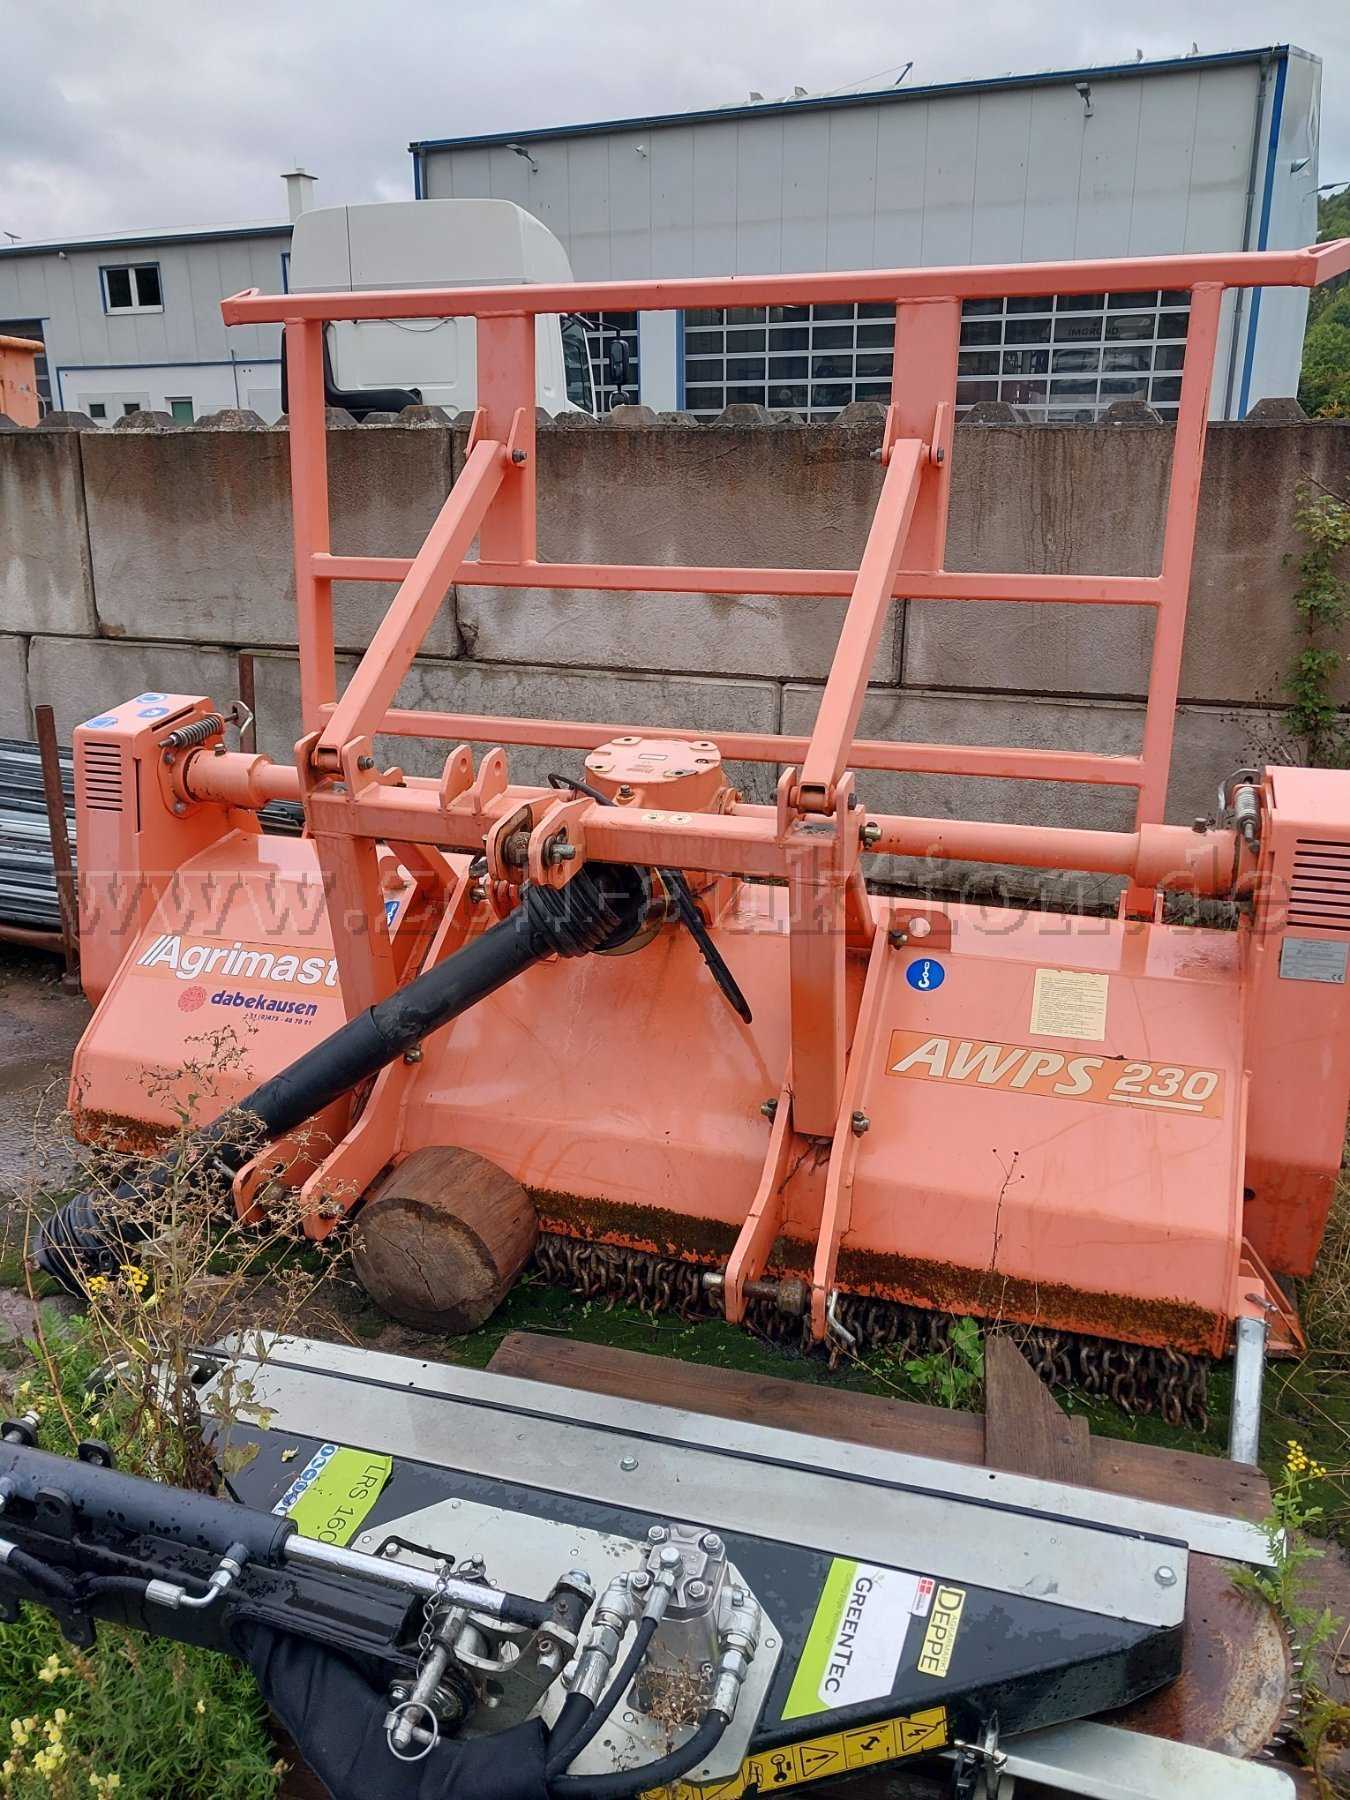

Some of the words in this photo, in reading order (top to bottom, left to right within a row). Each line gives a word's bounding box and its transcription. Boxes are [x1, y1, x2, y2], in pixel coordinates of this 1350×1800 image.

[211, 990, 319, 1017] dabekausen
[891, 1038, 1104, 1096] AWPS
[1113, 1063, 1219, 1102] 230
[348, 1465, 387, 1500] LRS
[318, 1505, 355, 1545] 160
[824, 1577, 873, 1694] GREENTEC
[920, 1589, 963, 1673] DEPPE
